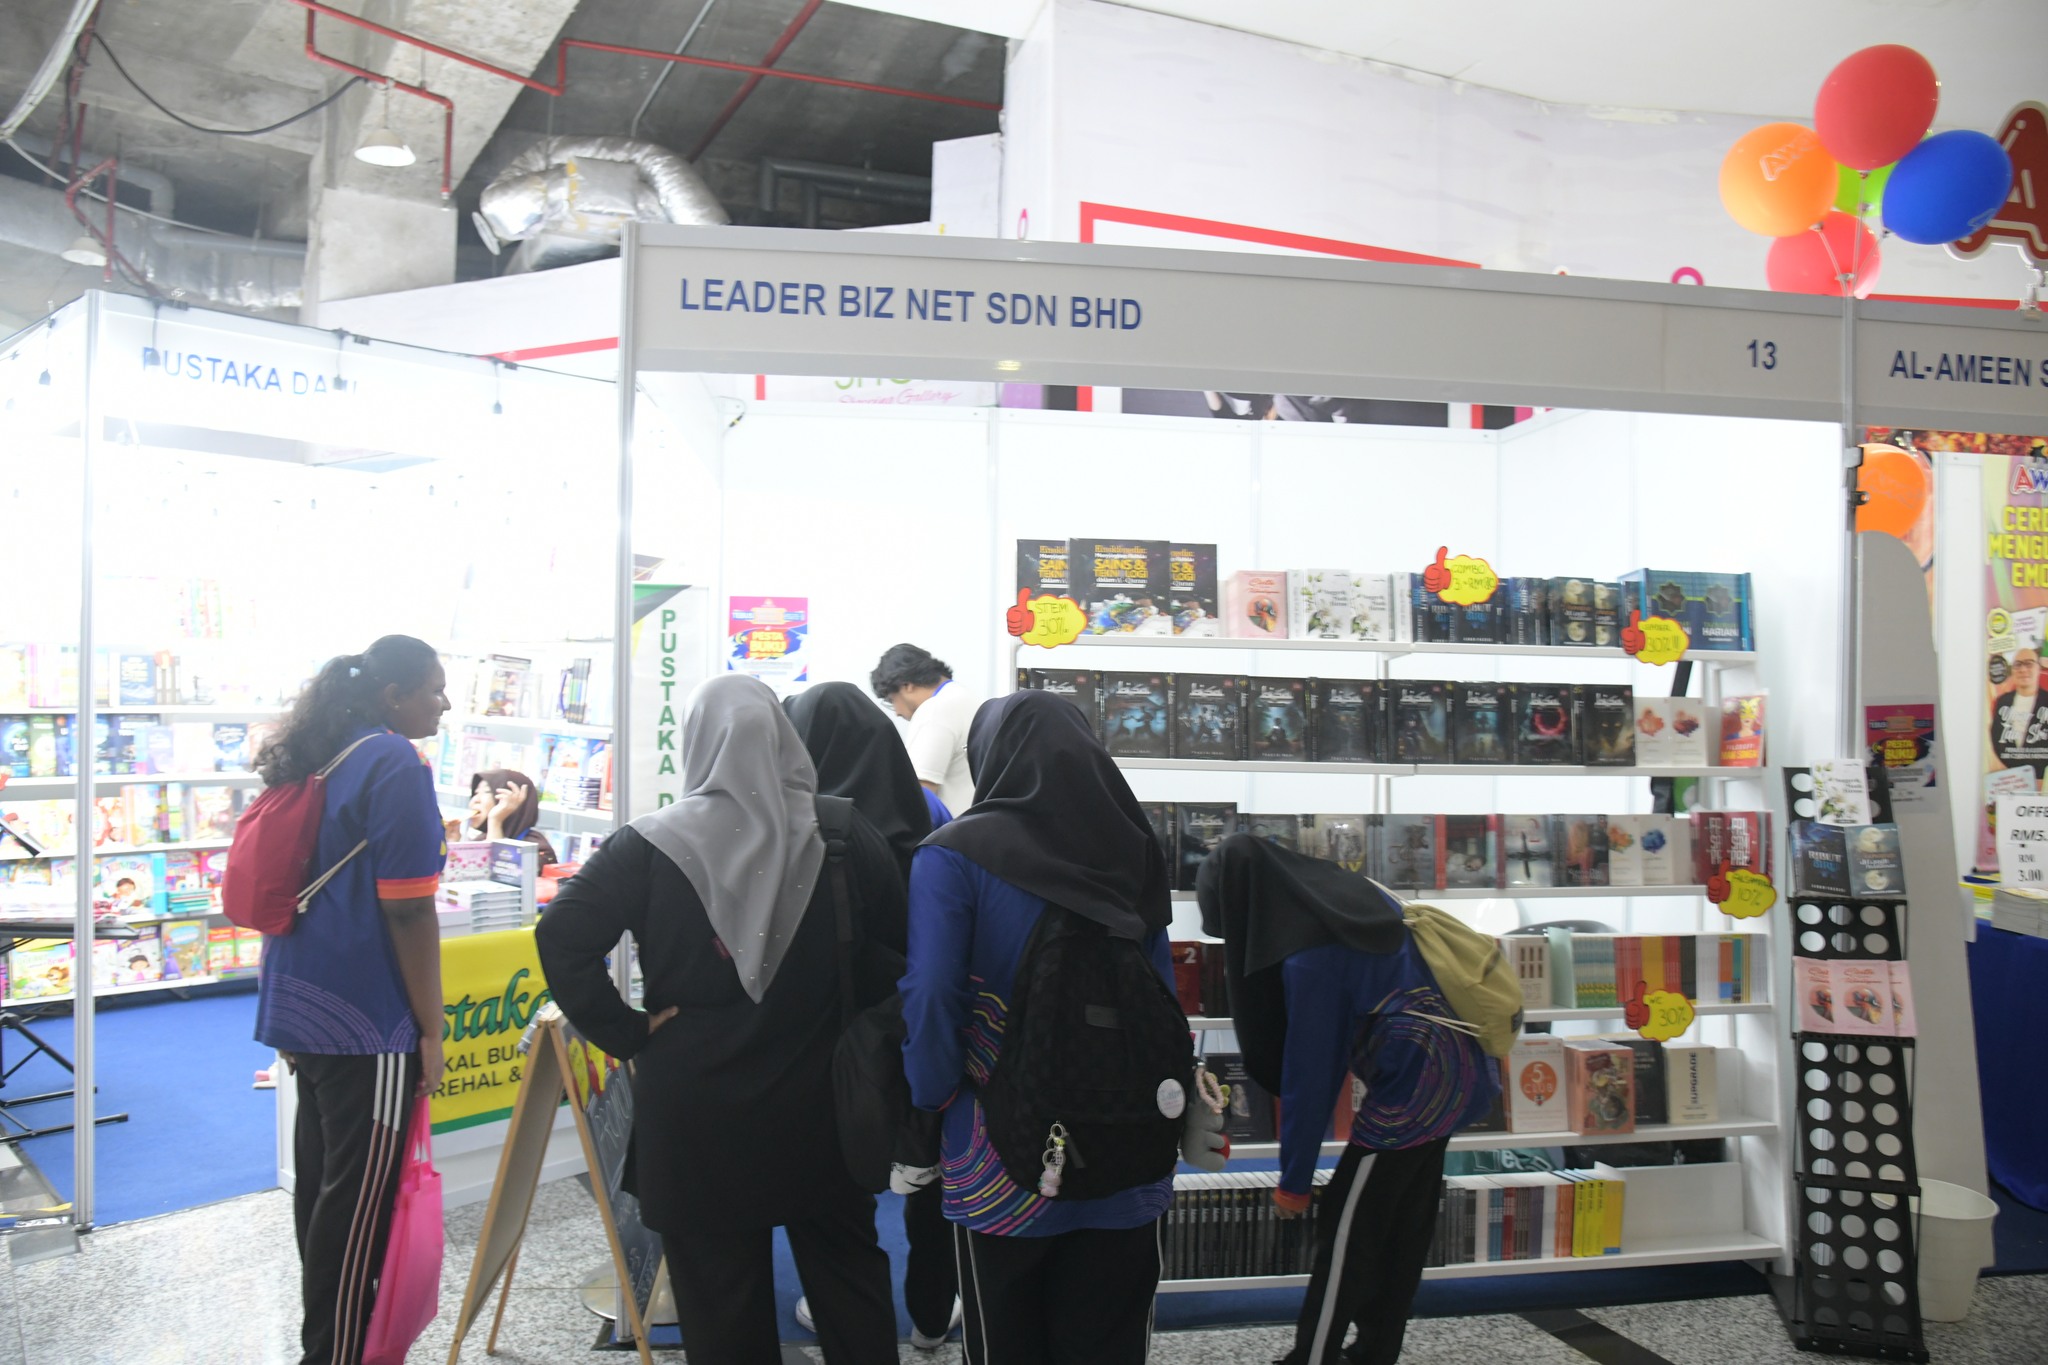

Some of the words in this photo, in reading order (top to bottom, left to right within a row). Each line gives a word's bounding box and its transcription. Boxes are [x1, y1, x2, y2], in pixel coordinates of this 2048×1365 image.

[680, 278, 827, 316] LEADER
[839, 284, 894, 319] BIZ
[906, 288, 975, 322] NET
[986, 291, 1058, 326] SDN
[1069, 296, 1142, 330] BHD
[1746, 339, 1777, 370] 13
[1889, 349, 2032, 387] AL-AMEEN
[1094, 559, 1133, 571] SAINS
[1134, 559, 1148, 571] &
[656, 609, 677, 775] PUSTAKA
[1184, 947, 1197, 964] 2
[1658, 1006, 1687, 1027] 30%
[1531, 1063, 1544, 1083] 5
